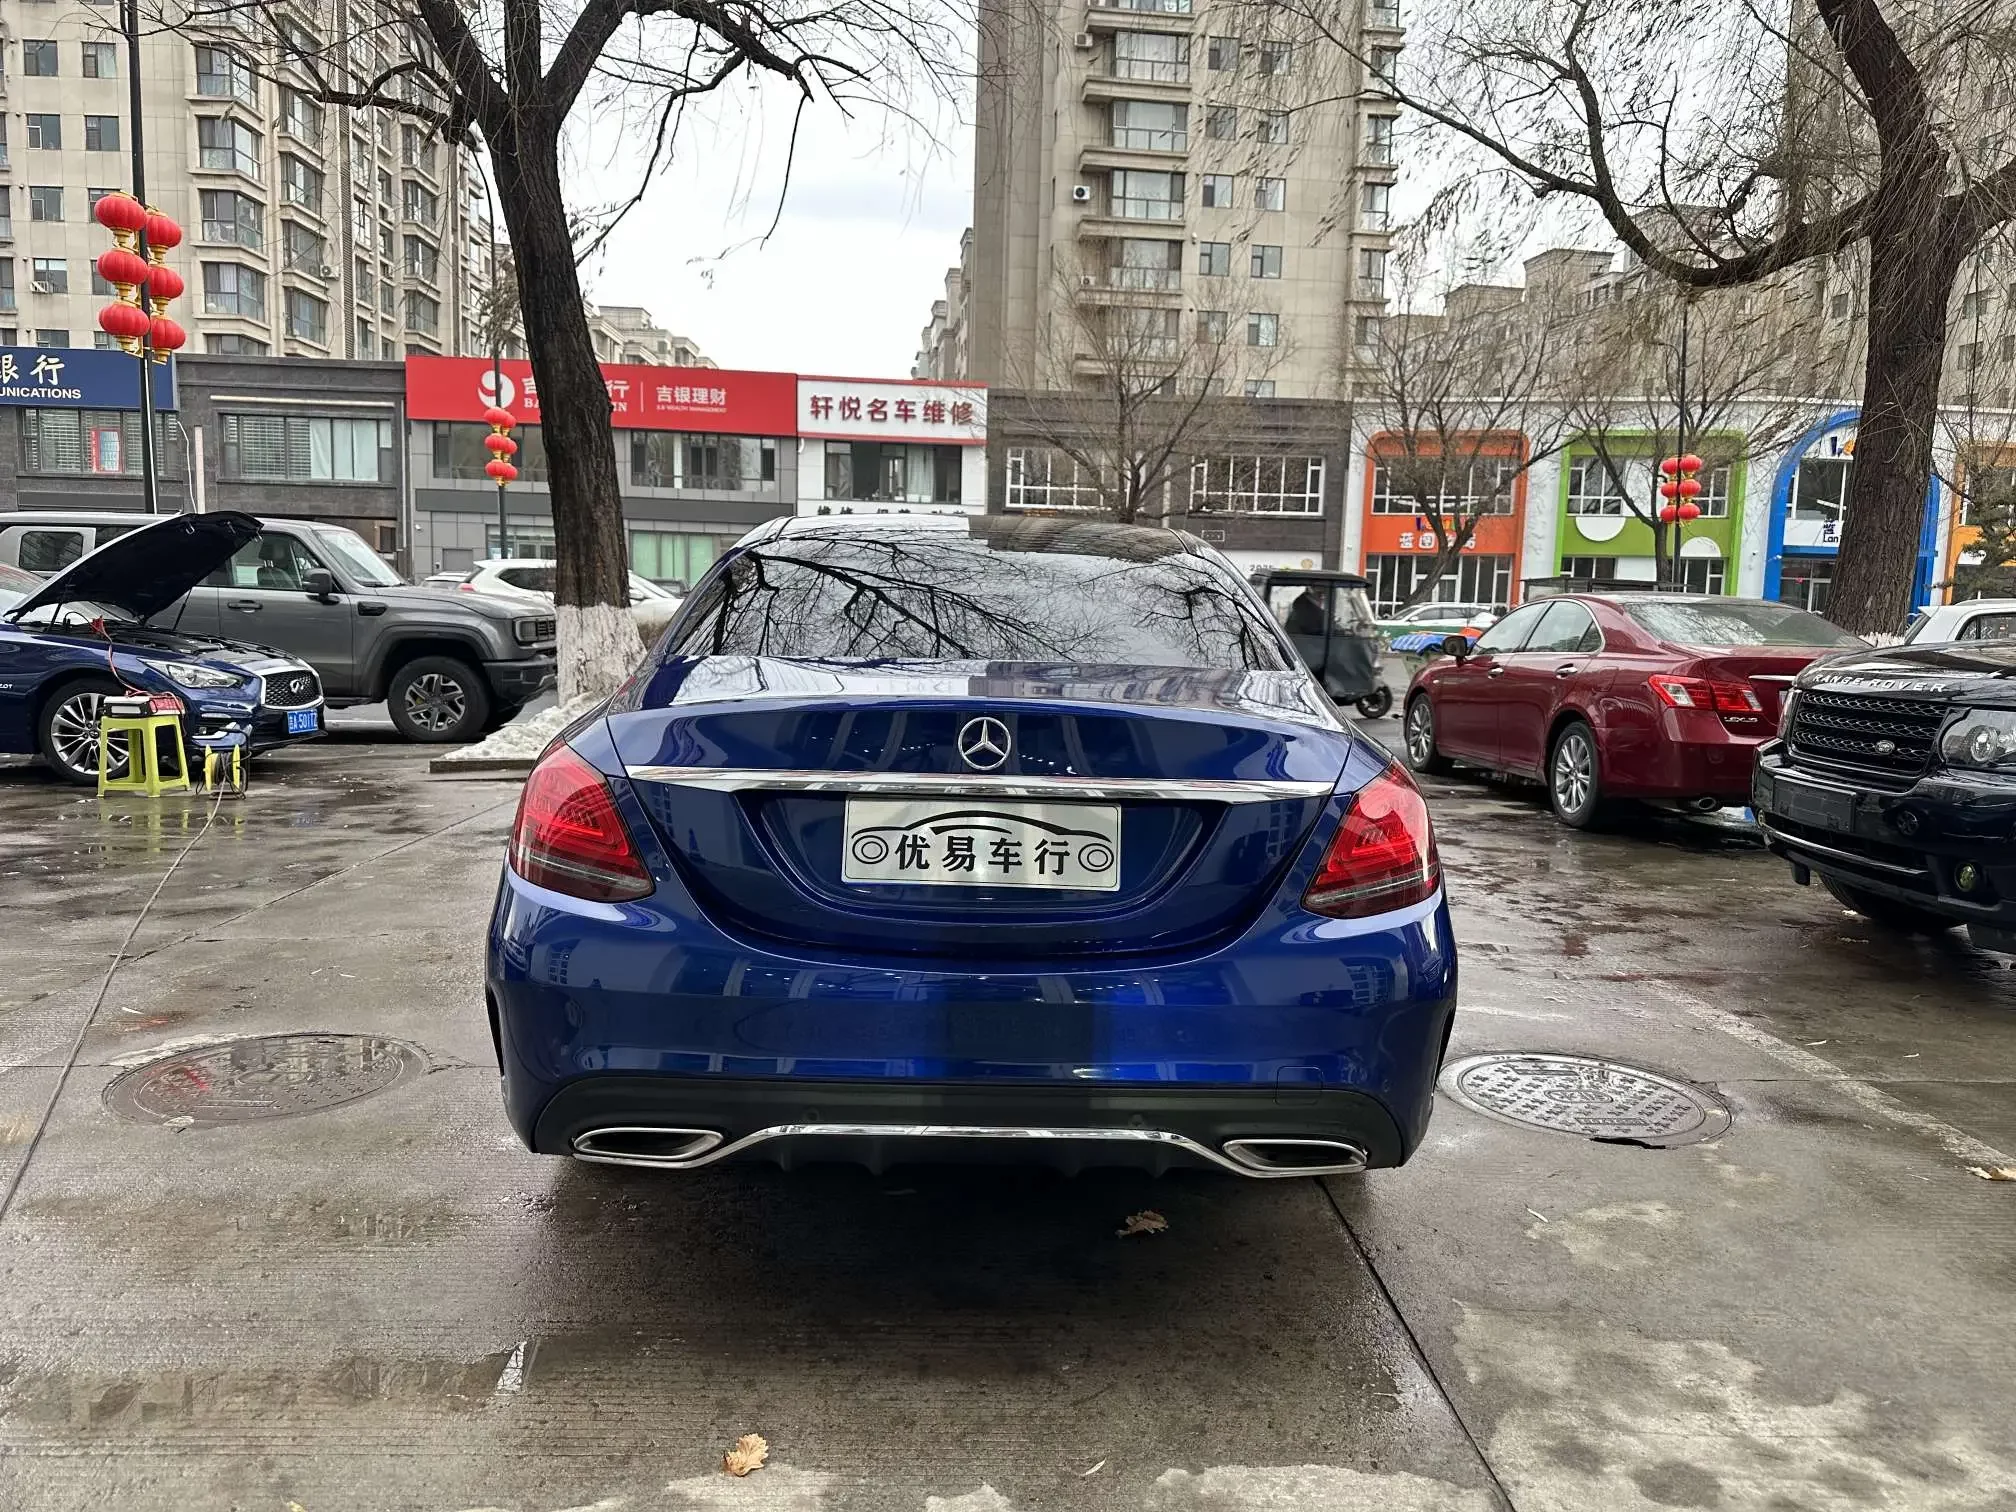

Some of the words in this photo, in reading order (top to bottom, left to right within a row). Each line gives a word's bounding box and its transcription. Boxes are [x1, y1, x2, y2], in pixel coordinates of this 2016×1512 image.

[656, 385, 727, 406] 吉银理财
[810, 394, 974, 426] 轩悦名车维修
[1812, 674, 1864, 685] RANGE
[1867, 678, 1947, 693] ROVER
[894, 834, 1071, 876] 优易车行
